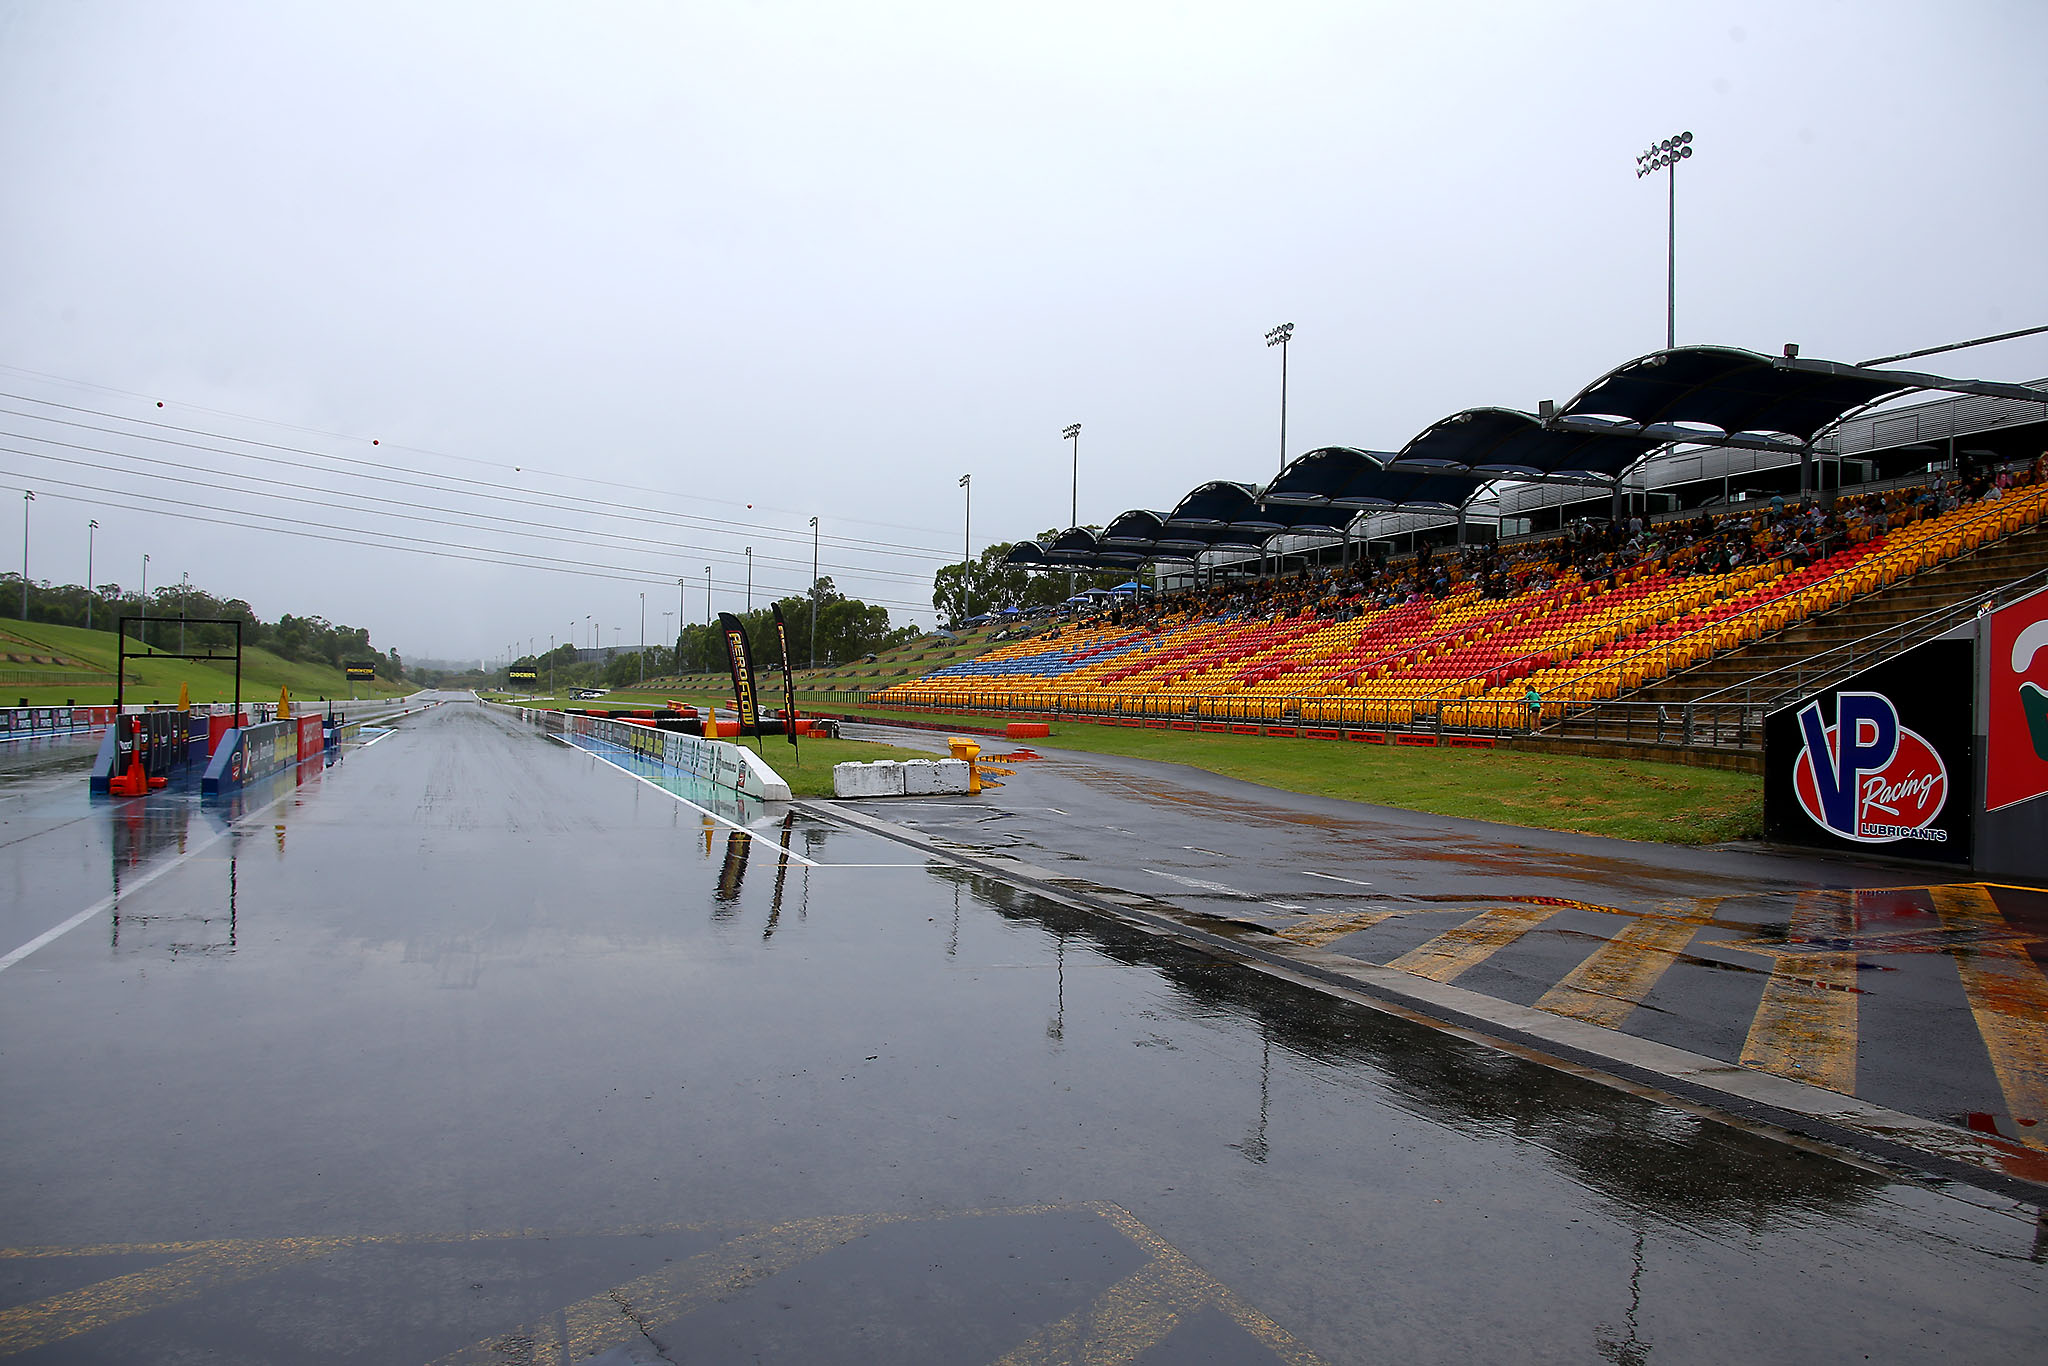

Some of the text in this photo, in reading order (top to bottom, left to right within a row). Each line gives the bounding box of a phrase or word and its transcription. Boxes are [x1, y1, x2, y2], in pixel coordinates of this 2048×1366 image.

[728, 632, 755, 726] AEROFLOW
[1797, 691, 1900, 838] VP
[1862, 769, 1939, 819] Racing
[1861, 822, 1948, 843] LUBRICANTS
